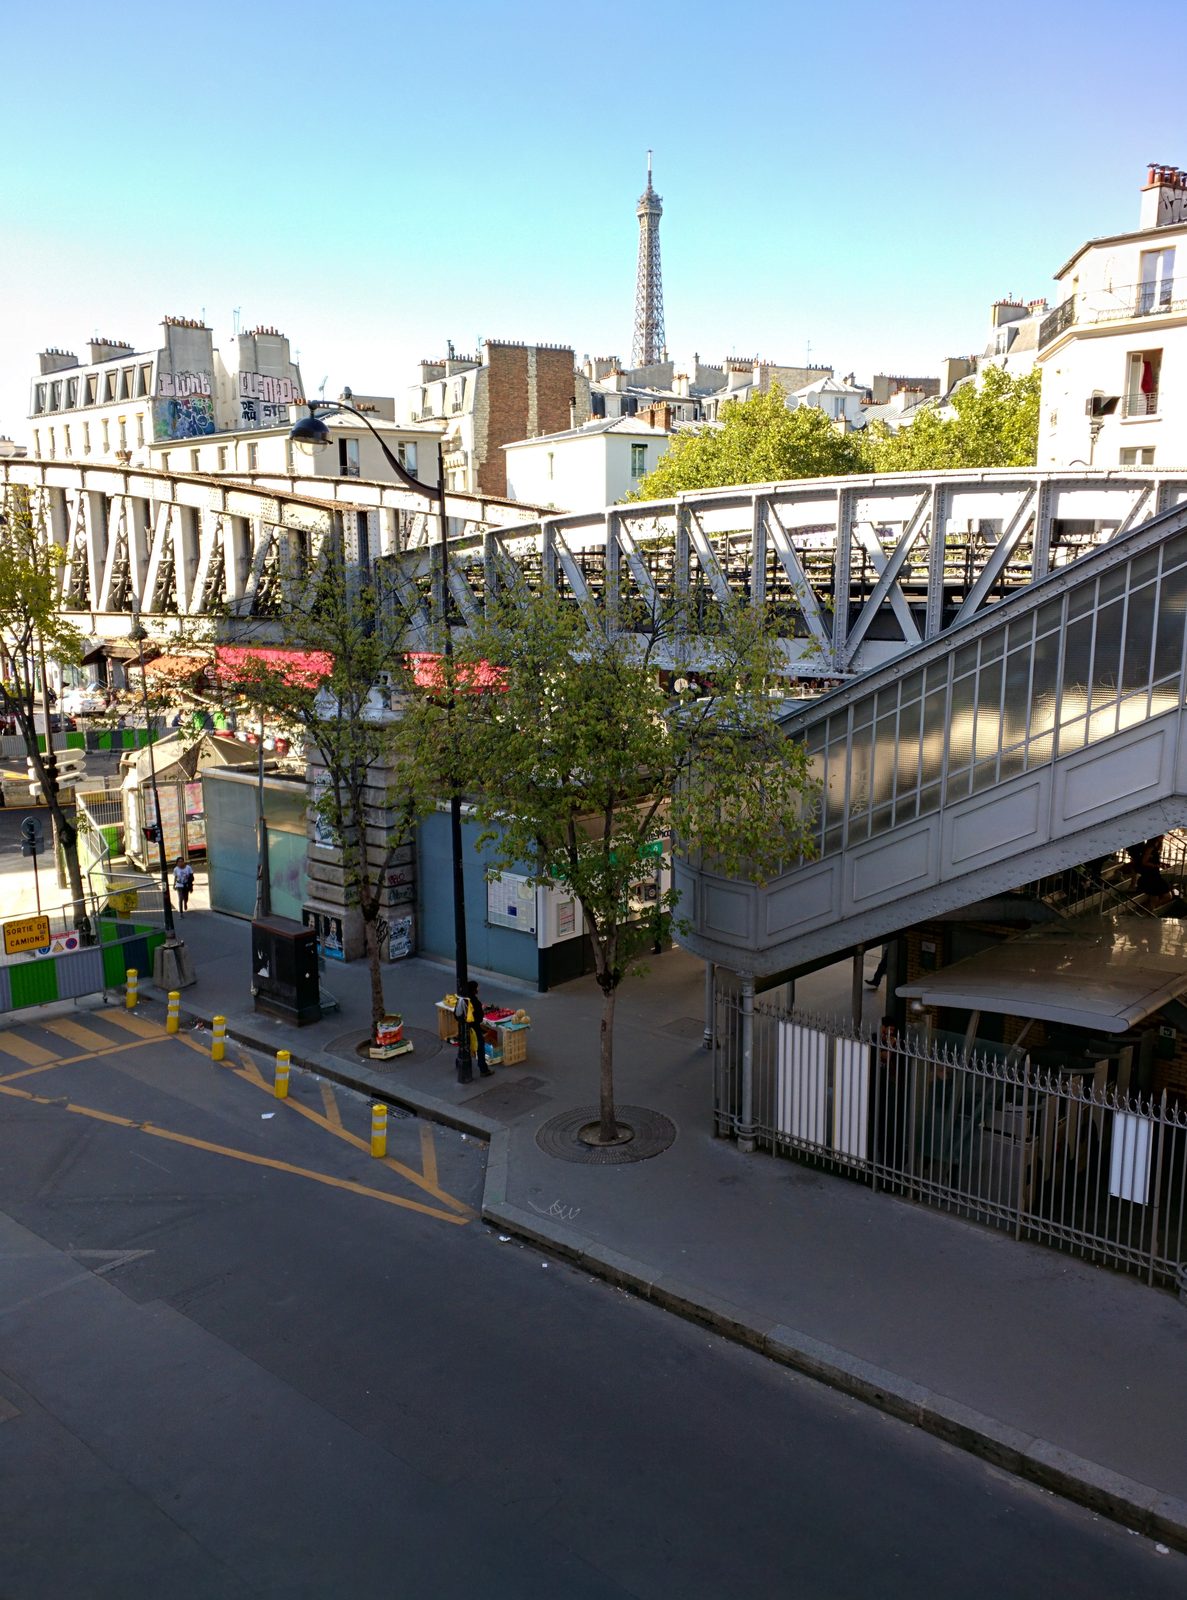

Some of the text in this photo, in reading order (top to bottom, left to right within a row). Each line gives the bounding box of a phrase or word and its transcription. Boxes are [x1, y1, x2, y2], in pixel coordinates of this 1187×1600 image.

[6, 922, 47, 936] SORTIE DE
[10, 935, 45, 947] CAMIONS
